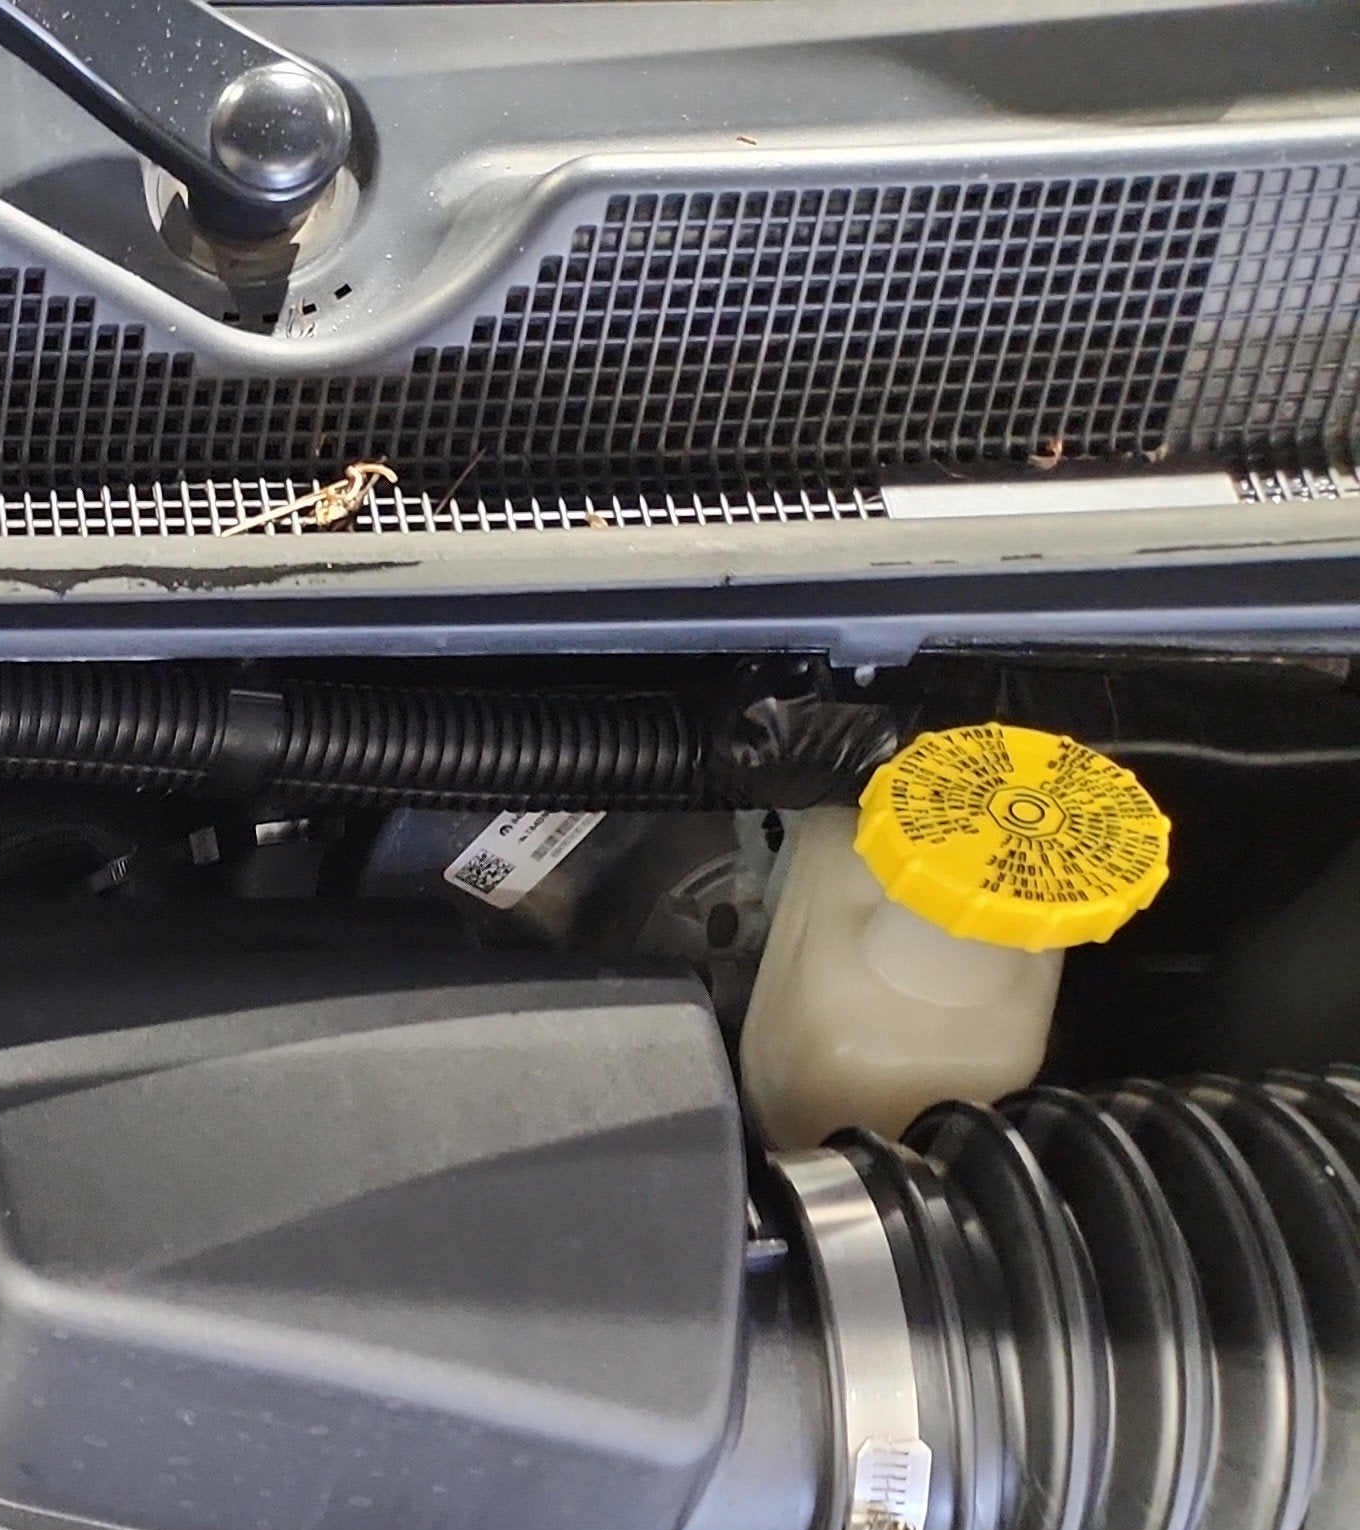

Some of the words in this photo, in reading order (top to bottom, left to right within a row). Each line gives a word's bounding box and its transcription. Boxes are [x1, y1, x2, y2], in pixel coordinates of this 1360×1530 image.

[1056, 740, 1098, 763] MISE
[1101, 764, 1124, 779] EN
[978, 878, 1000, 893] DE
[1012, 887, 1089, 902] BOUCHON
